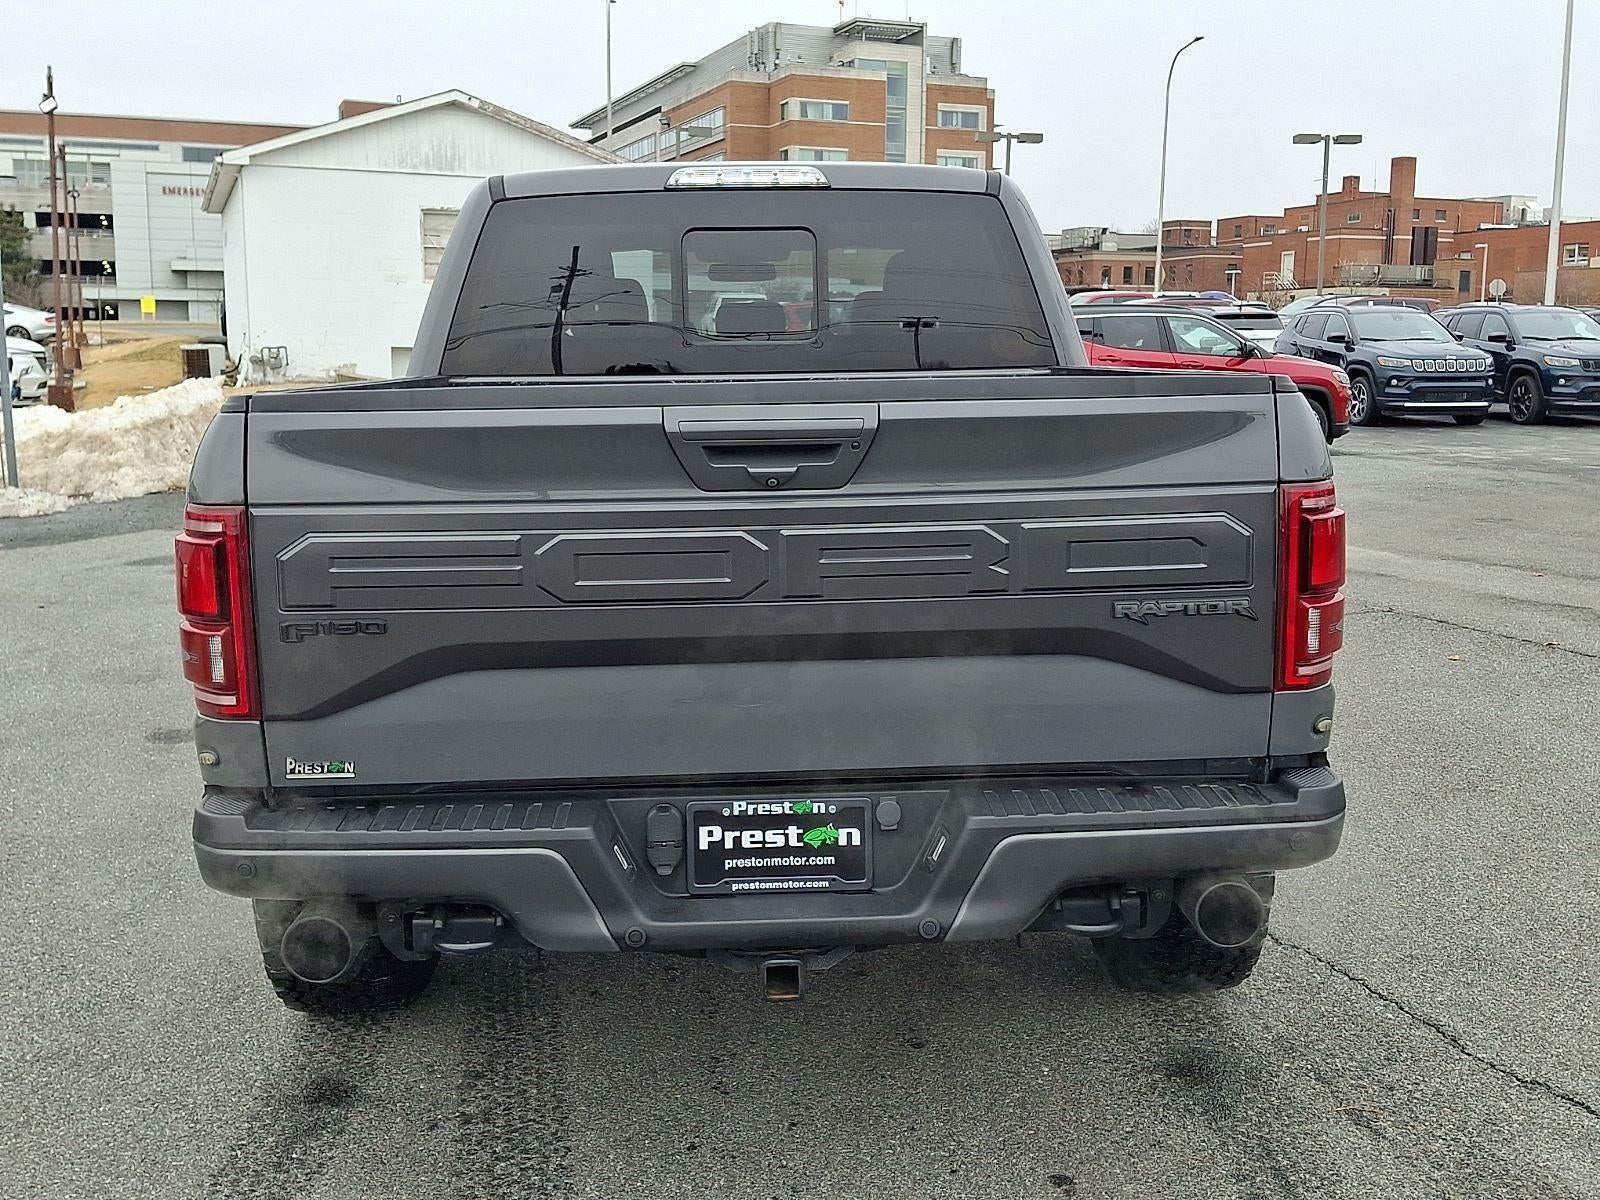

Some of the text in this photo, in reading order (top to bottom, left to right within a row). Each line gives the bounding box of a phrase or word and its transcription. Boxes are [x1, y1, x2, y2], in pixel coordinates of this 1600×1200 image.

[278, 512, 1254, 611] FORD
[1113, 597, 1258, 625] RAPTOR
[724, 855, 836, 870] prestonmotor.com
[731, 880, 830, 891] prestonmotor.com
